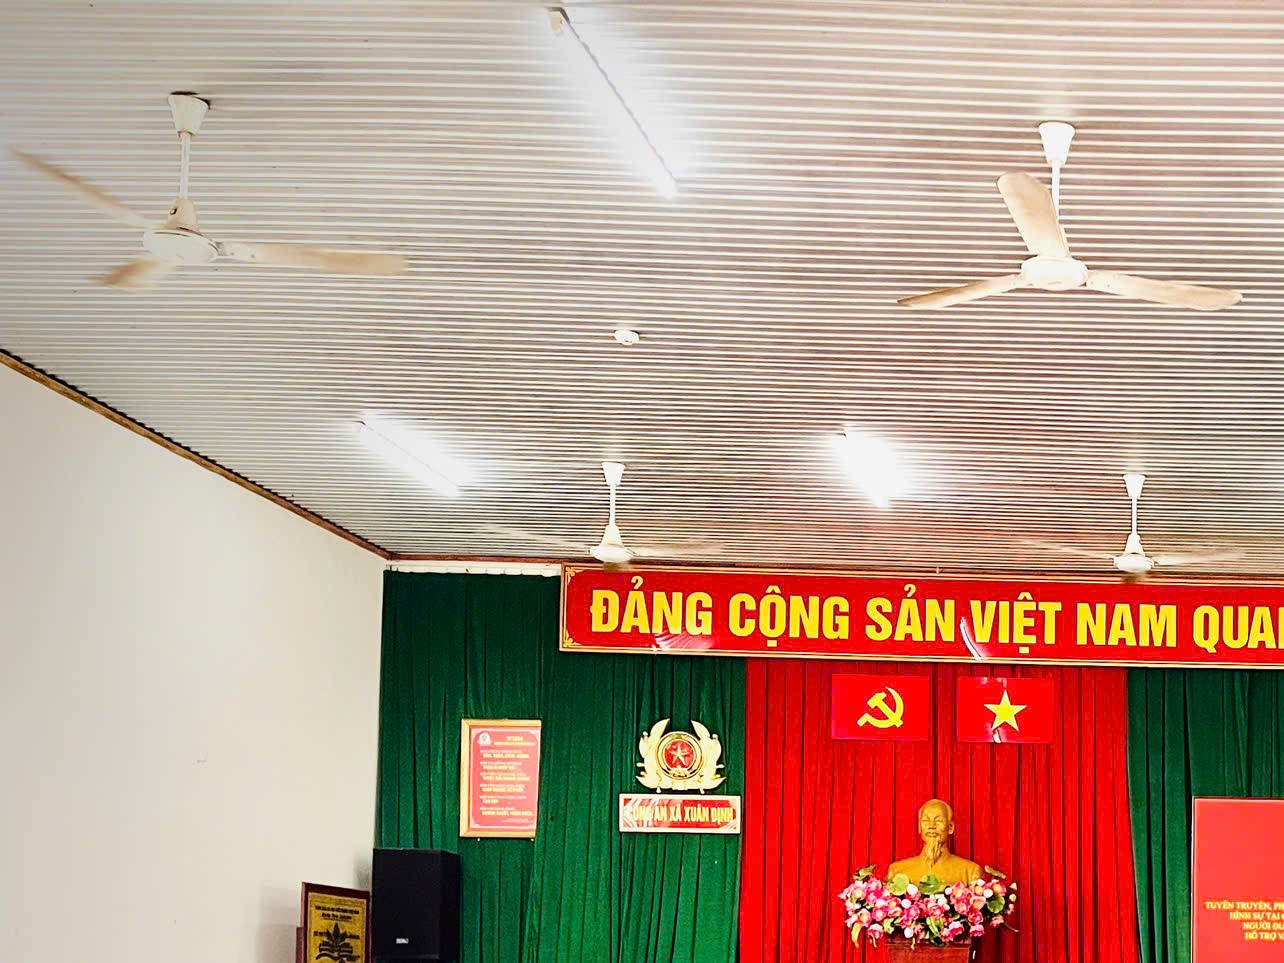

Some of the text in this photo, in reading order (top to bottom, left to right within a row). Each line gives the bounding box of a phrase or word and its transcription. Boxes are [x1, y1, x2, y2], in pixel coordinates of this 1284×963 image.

[590, 576, 713, 637] ĐẢNG
[729, 585, 850, 647] CỘNG
[865, 584, 955, 642] SẢN
[970, 592, 1062, 655] VIỆT
[1076, 602, 1177, 648] NAM
